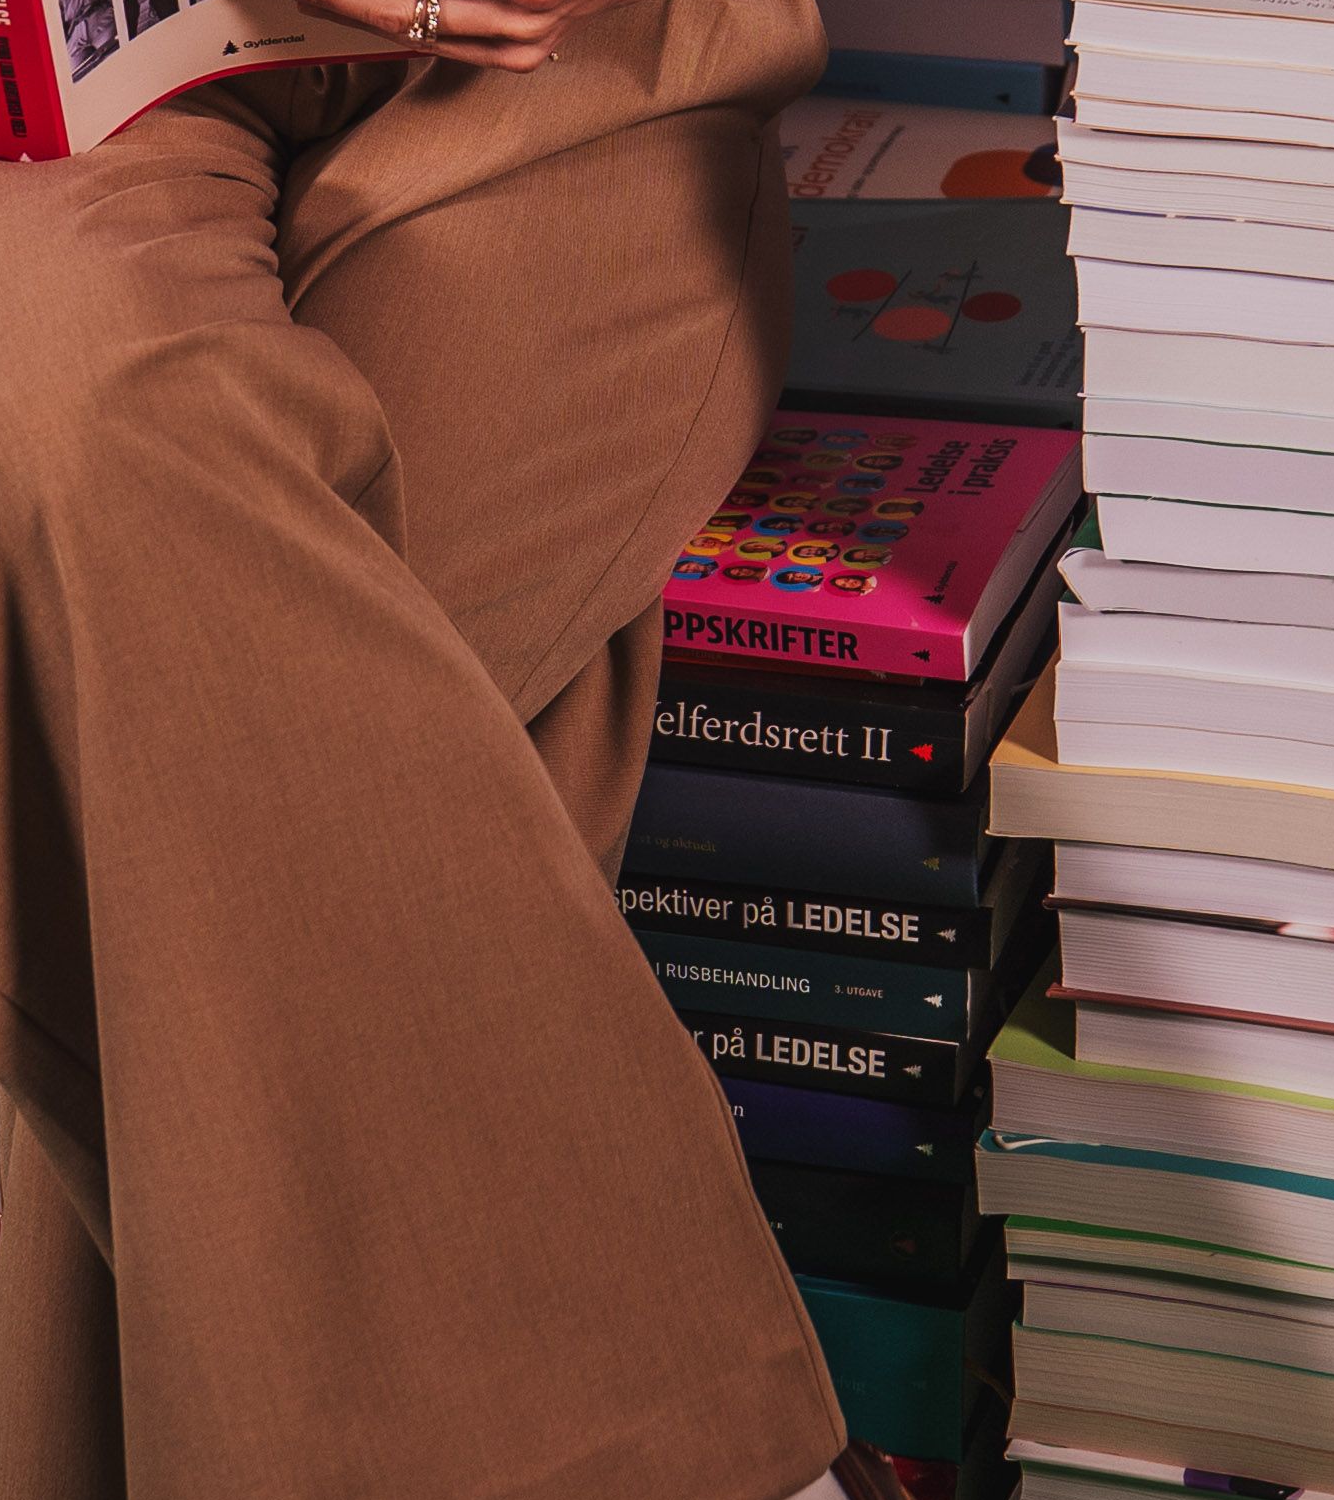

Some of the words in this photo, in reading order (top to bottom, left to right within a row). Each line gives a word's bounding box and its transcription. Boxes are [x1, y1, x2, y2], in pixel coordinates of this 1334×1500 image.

[243, 33, 306, 50] Gyldendal
[905, 438, 971, 495] Ledelse
[963, 437, 1018, 490] praksis
[665, 608, 860, 662] PPSKRIFTER
[861, 725, 893, 764] II
[612, 887, 733, 921] spektiver
[742, 896, 777, 929] på
[786, 900, 920, 944] LEDELSE
[665, 963, 811, 995] RUSBEHANDLING
[845, 985, 885, 1000] UTGAVE
[712, 1028, 747, 1061] på
[755, 1031, 886, 1079] LEDELSE
